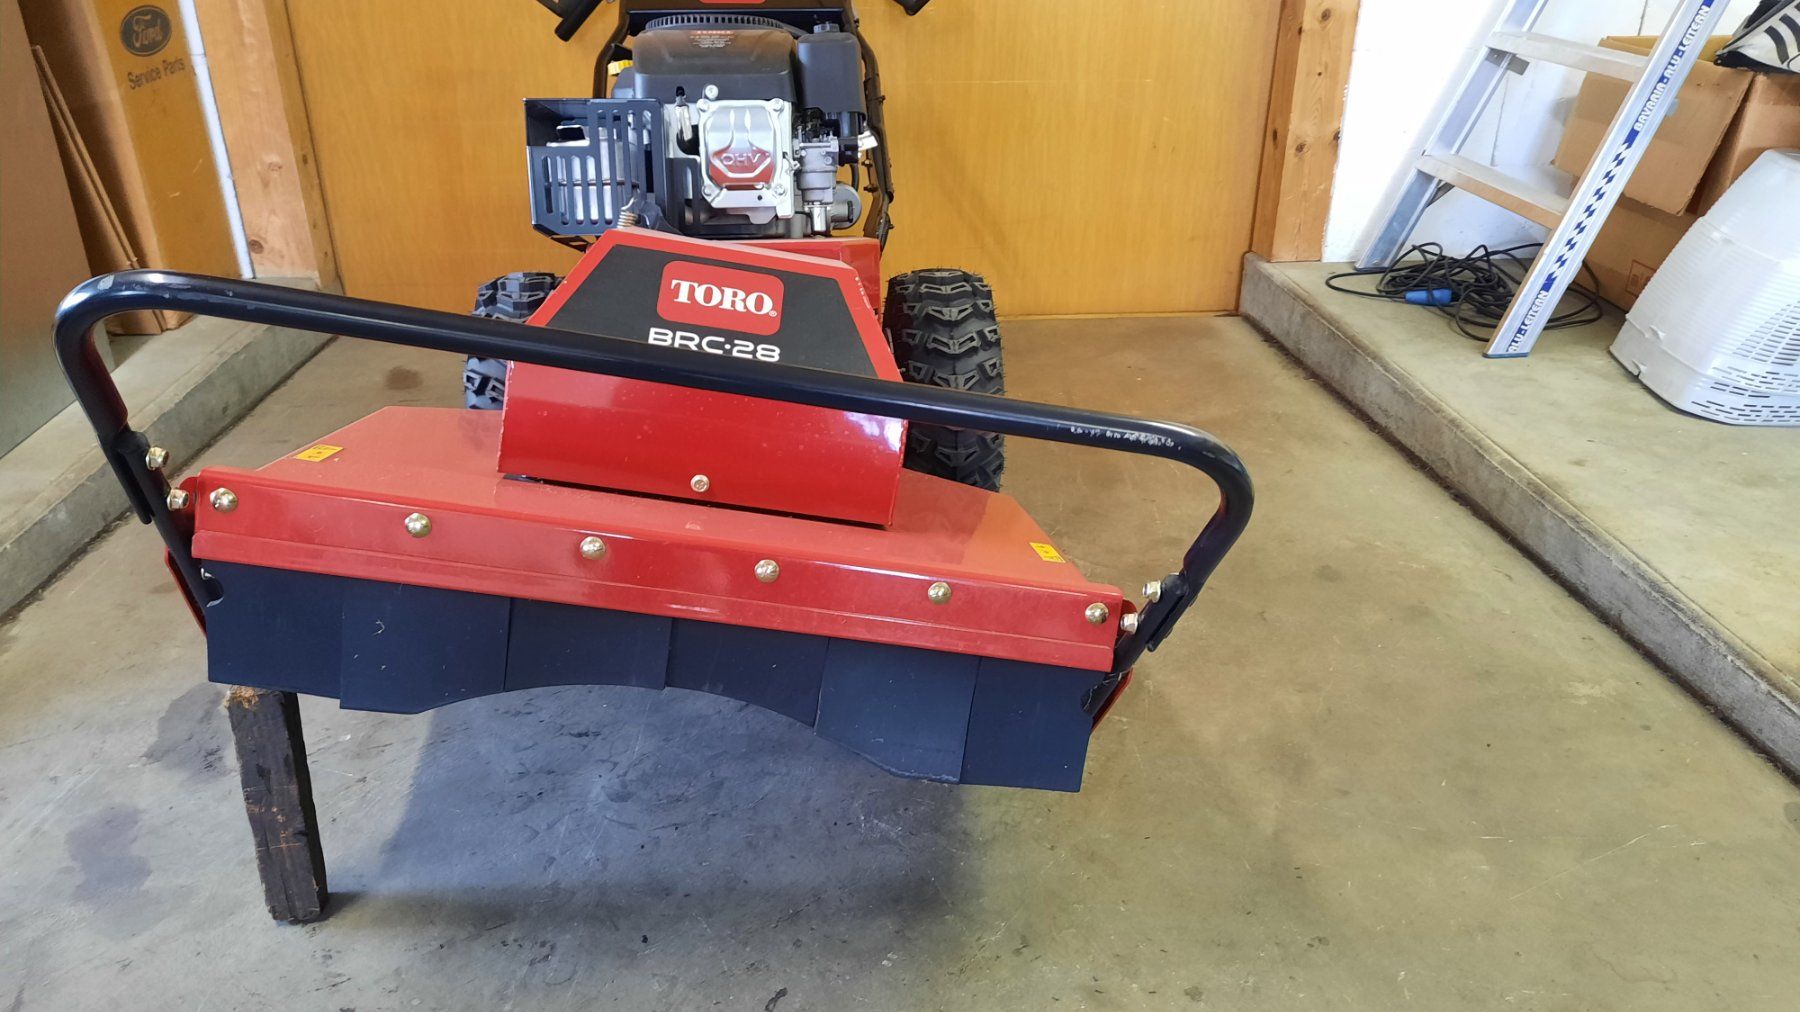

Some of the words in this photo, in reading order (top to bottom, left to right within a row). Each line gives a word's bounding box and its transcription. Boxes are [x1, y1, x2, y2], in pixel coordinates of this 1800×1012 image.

[132, 14, 163, 48] Ford
[127, 66, 161, 90] Service
[162, 58, 185, 76] Parts
[721, 152, 761, 165] OHV
[671, 279, 775, 316] TORO
